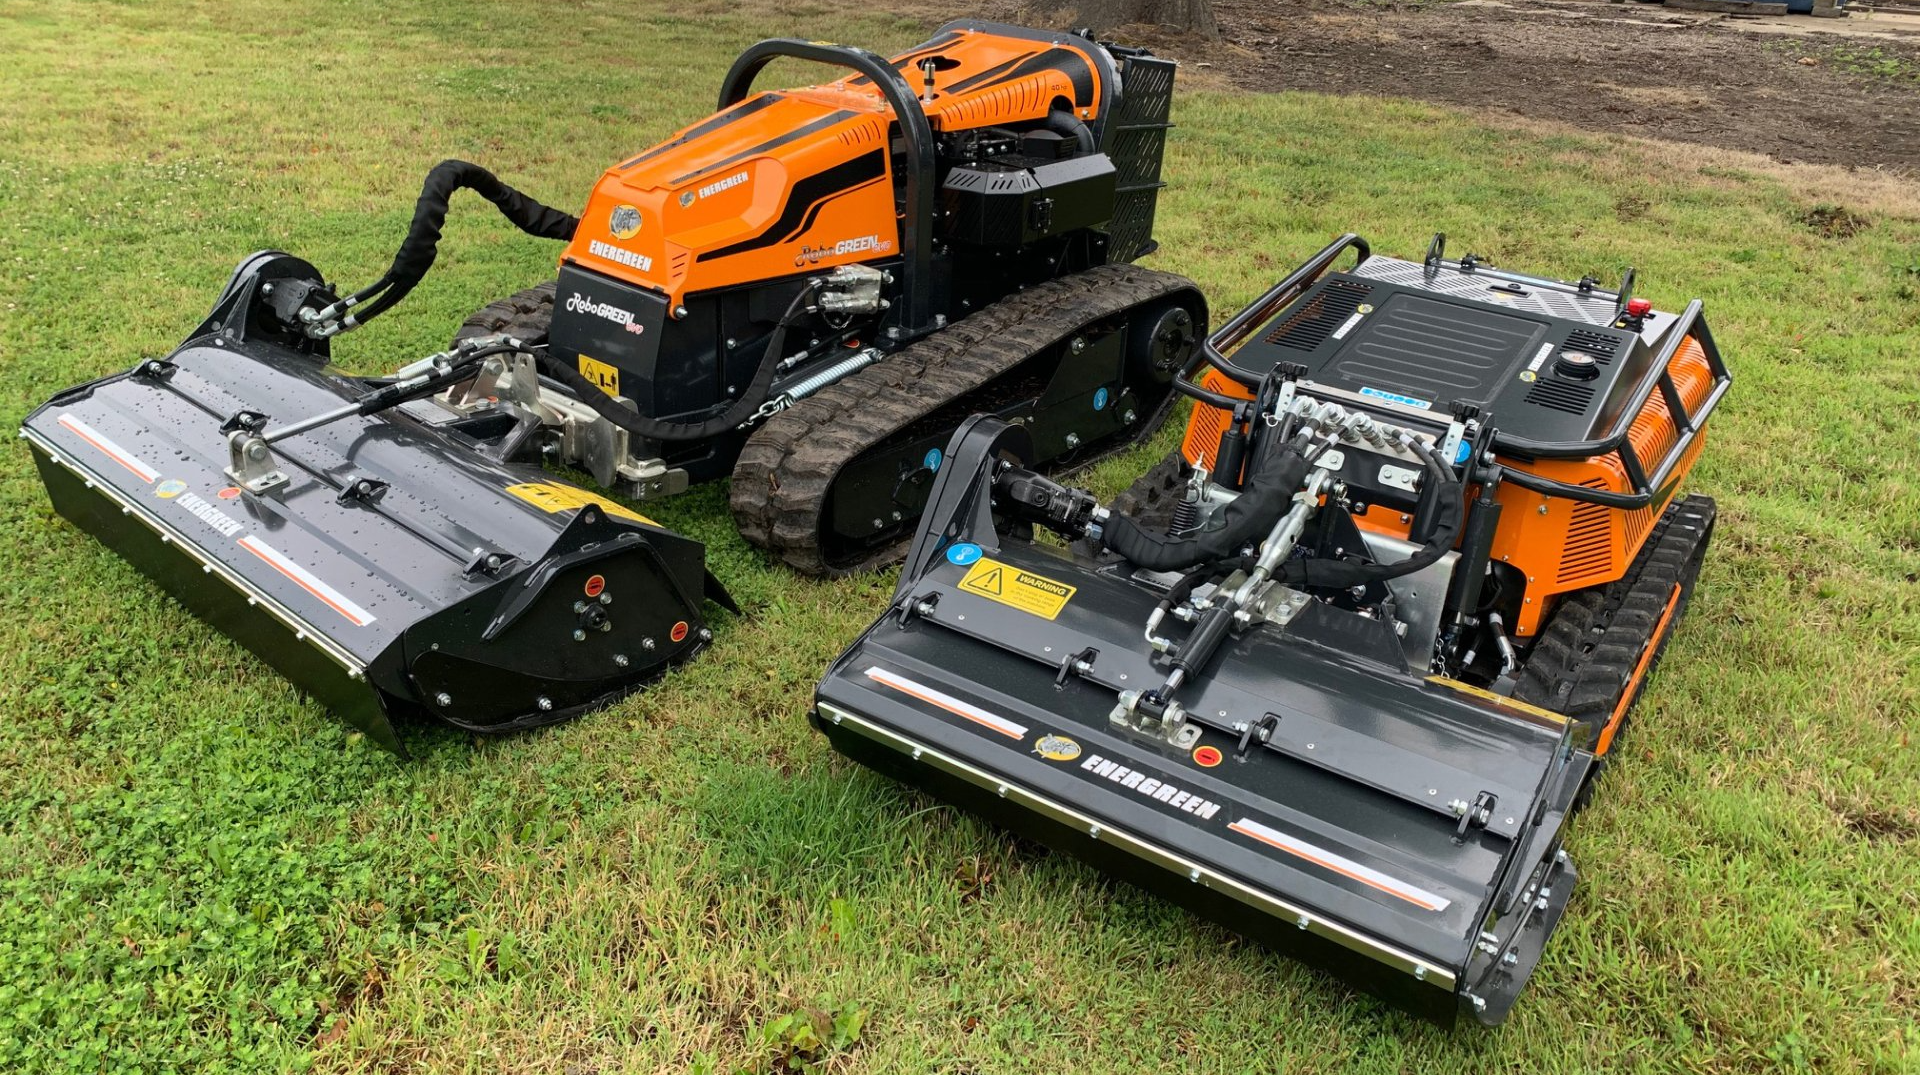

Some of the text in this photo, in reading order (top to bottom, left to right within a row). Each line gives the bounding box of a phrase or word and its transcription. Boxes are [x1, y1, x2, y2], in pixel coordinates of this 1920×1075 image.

[699, 171, 749, 199] ENERGREEN
[589, 240, 652, 272] ENERGREEN
[176, 492, 244, 537] ENERGREEN
[1020, 574, 1067, 596] WARNING
[1080, 754, 1221, 820] ENERGREEN
